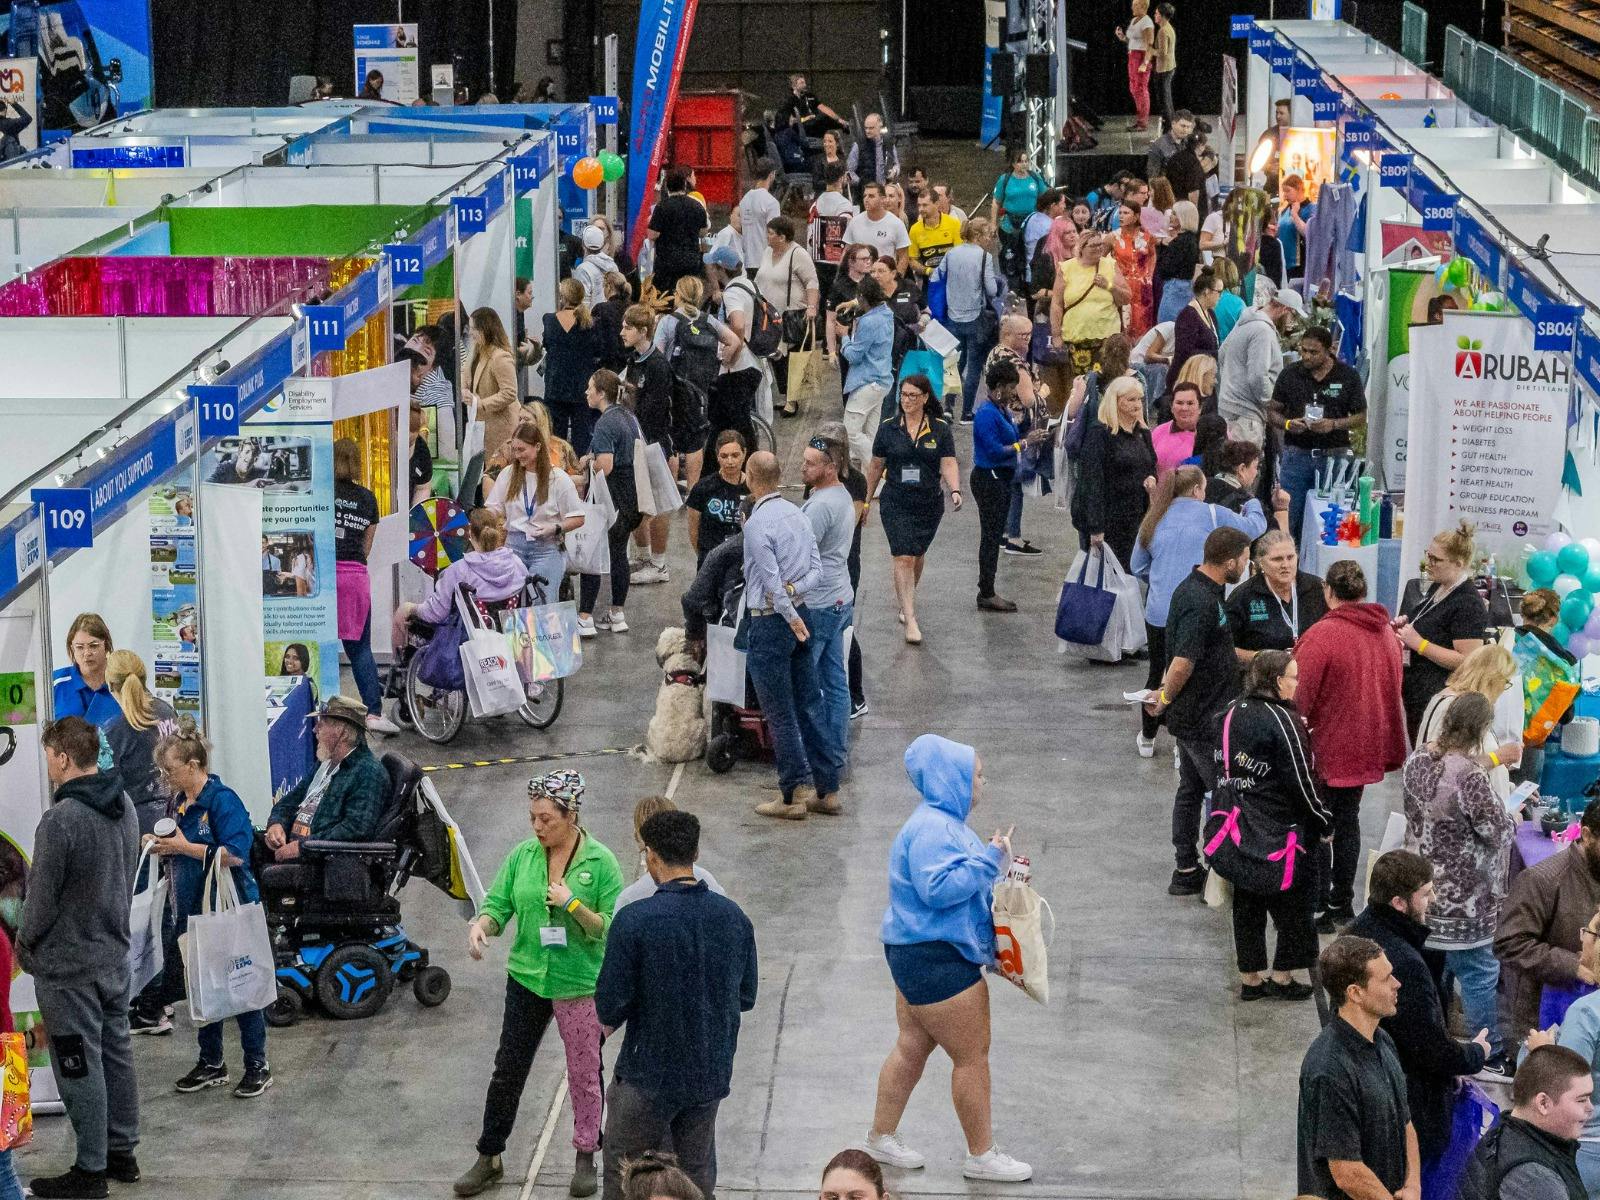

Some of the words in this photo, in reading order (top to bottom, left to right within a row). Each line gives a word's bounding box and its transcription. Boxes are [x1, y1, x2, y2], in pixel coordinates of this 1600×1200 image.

[1252, 39, 1271, 47] SB14
[1273, 58, 1292, 66] SB13
[1296, 79, 1317, 88] SB12
[598, 106, 615, 116] 116
[1314, 102, 1336, 112] SB11
[559, 135, 578, 146] 115
[1345, 132, 1370, 142] SB10
[516, 168, 537, 180] 114
[1381, 165, 1408, 177] SB09
[460, 209, 483, 222] 113
[1424, 207, 1453, 219] SB08
[395, 258, 420, 273] 112
[312, 320, 338, 336] 111
[1537, 321, 1573, 336] SB06
[1457, 351, 1569, 385] ARUBAH
[288, 390, 316, 399] Disability
[1516, 384, 1569, 393] DIETITIANS
[288, 397, 326, 406] Employment
[1454, 399, 1467, 407] WE
[1470, 400, 1486, 409] ARE
[1488, 401, 1540, 412] PASSIONATE
[202, 403, 235, 421] 110
[1453, 409, 1482, 418] ABOUT
[1484, 410, 1520, 421] HELPING
[1522, 412, 1552, 423] PEOPLE
[1462, 424, 1492, 433] WEIGHT
[1494, 426, 1513, 435] LOSS
[1461, 437, 1497, 447] DIABETES
[1461, 451, 1477, 460] GUT
[1479, 452, 1507, 461] HEALTH
[1460, 464, 1489, 474] SPORTS
[1490, 466, 1534, 477] NUTRITION
[95, 478, 115, 510] ABOUT
[127, 450, 154, 486] SUPPORTS
[1460, 478, 1484, 487] HEART
[1485, 479, 1513, 489] HEALTH
[1459, 491, 1487, 500] GROUP
[1489, 493, 1535, 504] EDUCATION
[274, 504, 330, 514] opportunities
[1459, 505, 1497, 515] WELLNESS
[1499, 507, 1539, 518] PROGRAM
[50, 509, 86, 529] 109
[274, 516, 293, 524] your
[294, 515, 316, 525] goals
[343, 513, 371, 526] change
[343, 519, 366, 531] better
[27, 547, 39, 567] EXPO
